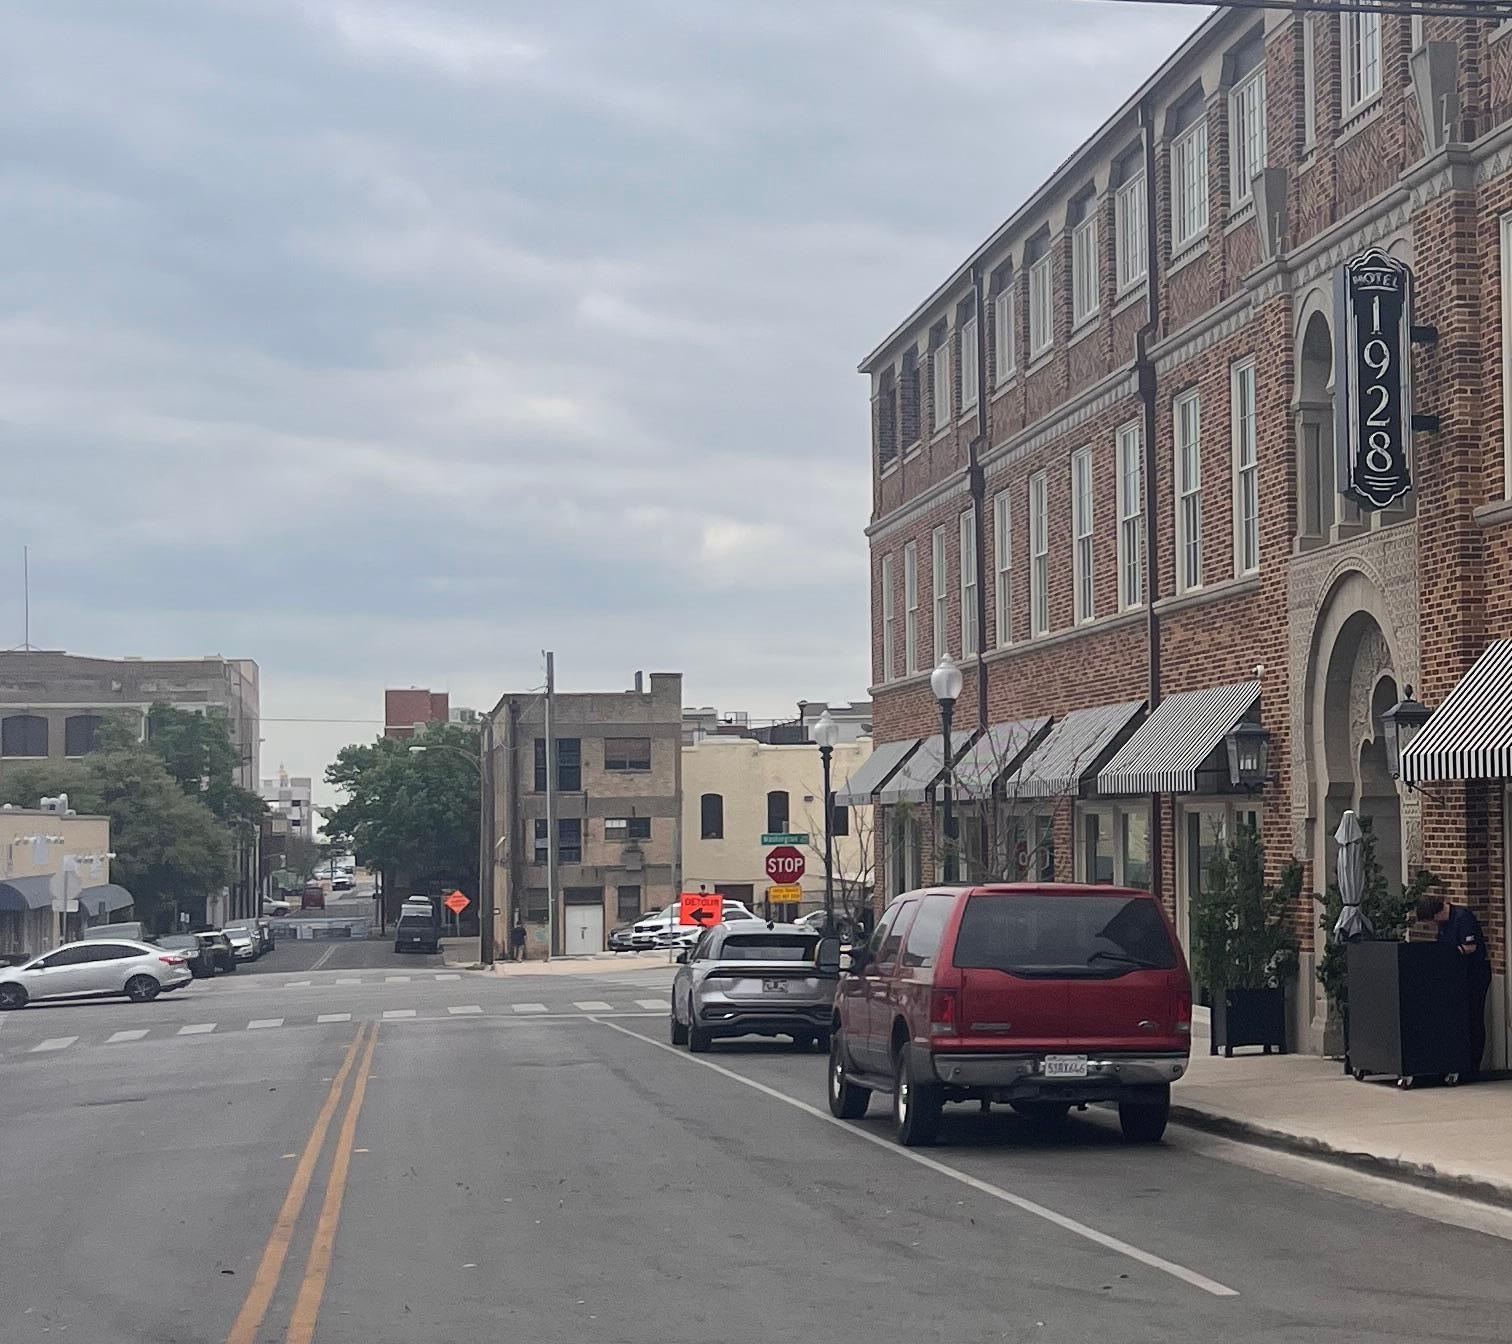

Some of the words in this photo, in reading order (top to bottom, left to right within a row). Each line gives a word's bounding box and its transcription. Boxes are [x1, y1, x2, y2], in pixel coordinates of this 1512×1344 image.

[1363, 295, 1393, 472] 1928
[768, 857, 804, 873] STOP
[685, 898, 720, 907] DETOUR
